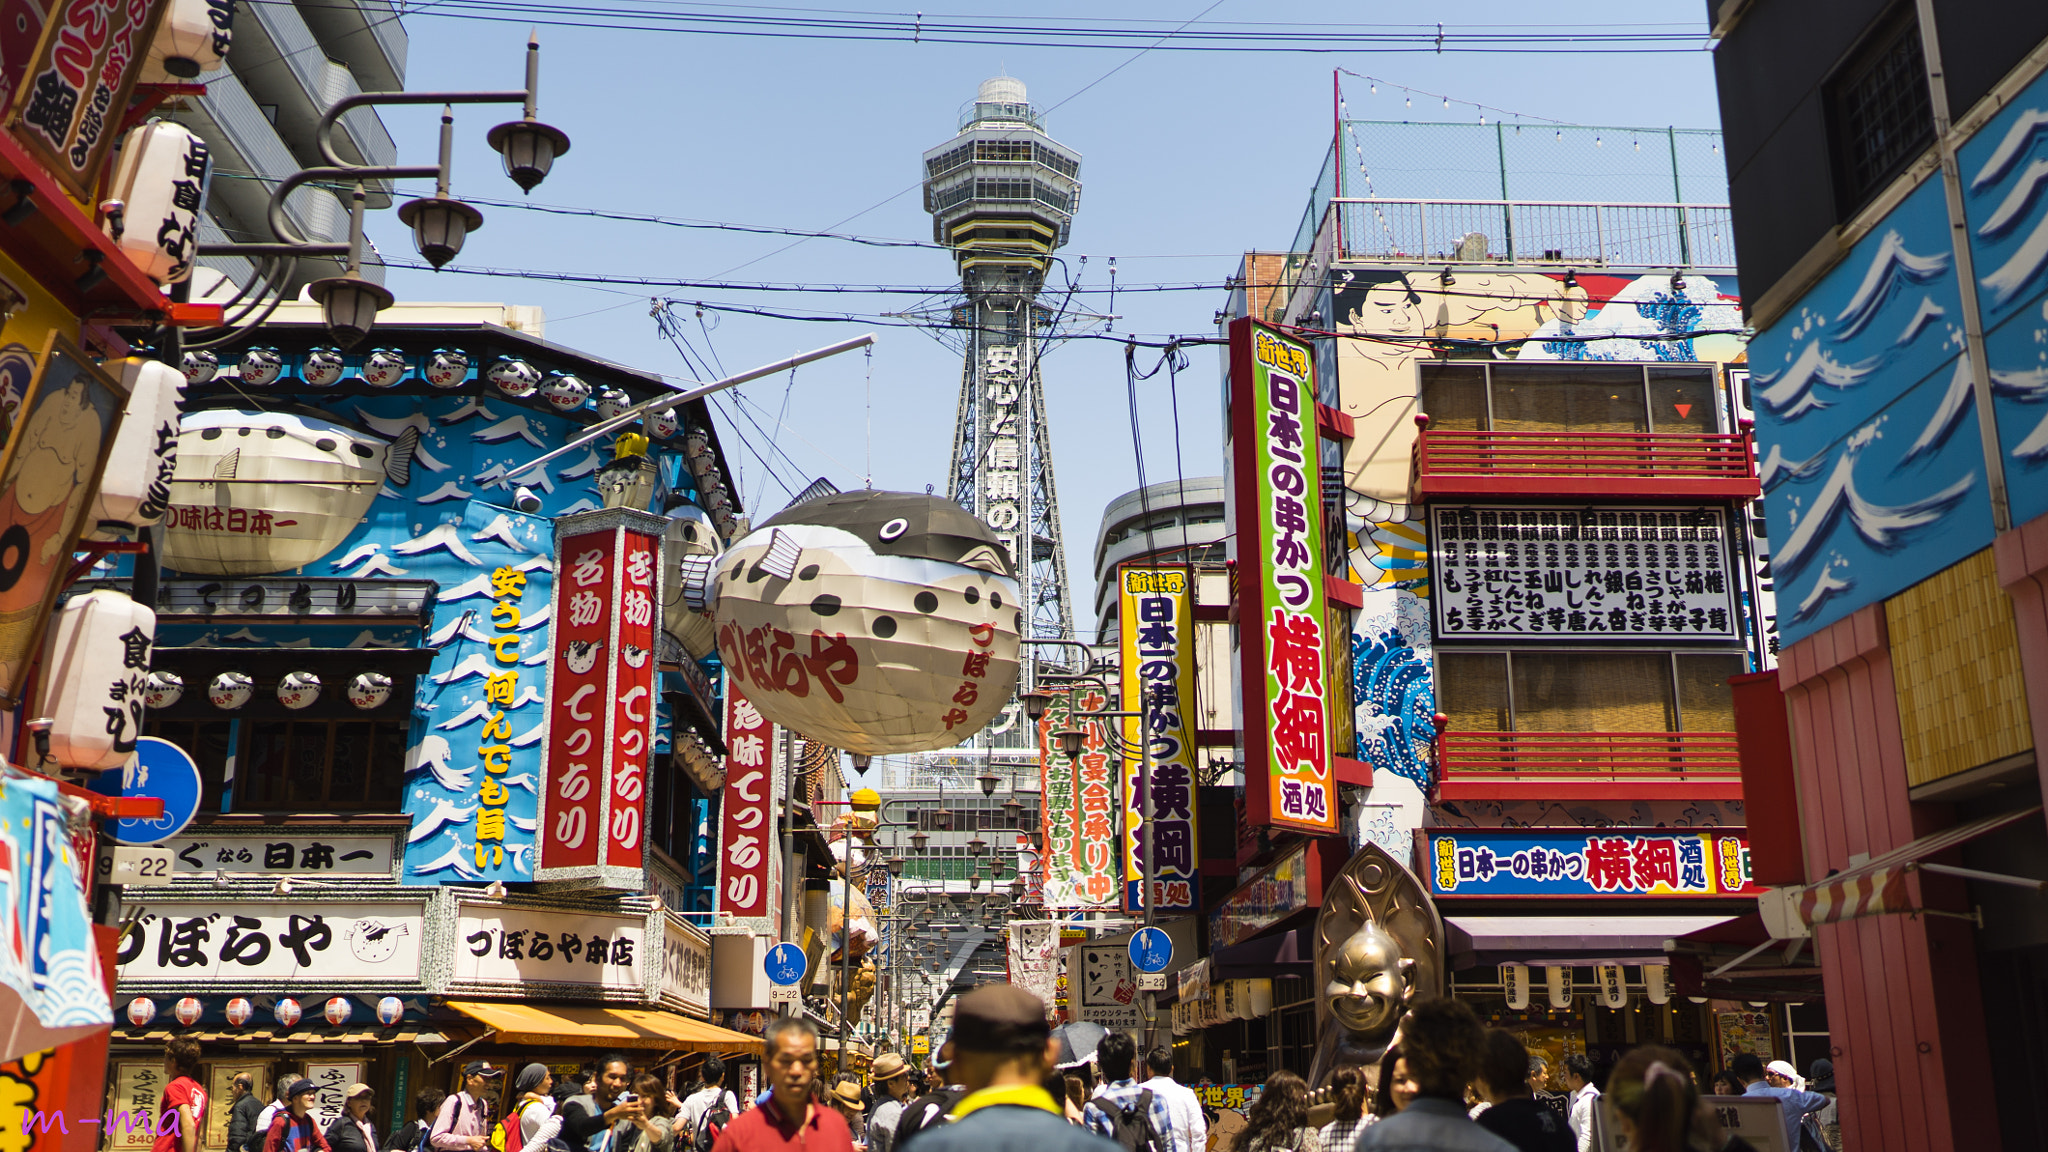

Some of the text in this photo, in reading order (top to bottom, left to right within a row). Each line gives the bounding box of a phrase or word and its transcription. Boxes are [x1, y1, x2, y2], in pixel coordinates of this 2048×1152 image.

[1257, 332, 1307, 379] 新世界
[1269, 373, 1310, 605] 日本一の串かつ
[1127, 572, 1186, 593] 新世界
[1444, 569, 1463, 631] もち
[1464, 569, 1486, 631] うずら玉子
[1504, 569, 1525, 631] にんにく
[1524, 569, 1546, 631] 玉ねぎ
[1544, 569, 1566, 631] 山芋
[1565, 569, 1587, 631] しし唐
[1584, 569, 1607, 631] れんこん
[1604, 570, 1627, 631] 銀杏
[1625, 570, 1647, 631] 白ねぎ
[1645, 570, 1667, 631] さつま芋
[1685, 570, 1707, 631] 茄子
[1704, 570, 1727, 631] 椎茸
[719, 619, 859, 704] づぼらや
[942, 621, 998, 731] づぼらや
[1138, 597, 1179, 760] 日本一の串かつ
[475, 565, 527, 869] 安うて何んでも旨い
[1270, 609, 1326, 777] 横綱
[1080, 692, 1111, 901] 大小宴会承り中
[1131, 765, 1191, 875] 横綱
[1283, 780, 1325, 818] 酒処
[153, 842, 374, 869] ぐなら日本一
[1438, 839, 1456, 888] 新世界
[1458, 849, 1583, 880] 日本一の串かつ
[1586, 838, 1679, 890] 横綱
[1680, 839, 1706, 889] 酒処
[1722, 839, 1741, 889] 新世界
[116, 913, 333, 968] づぼらや
[466, 928, 635, 966] づぼらや本店
